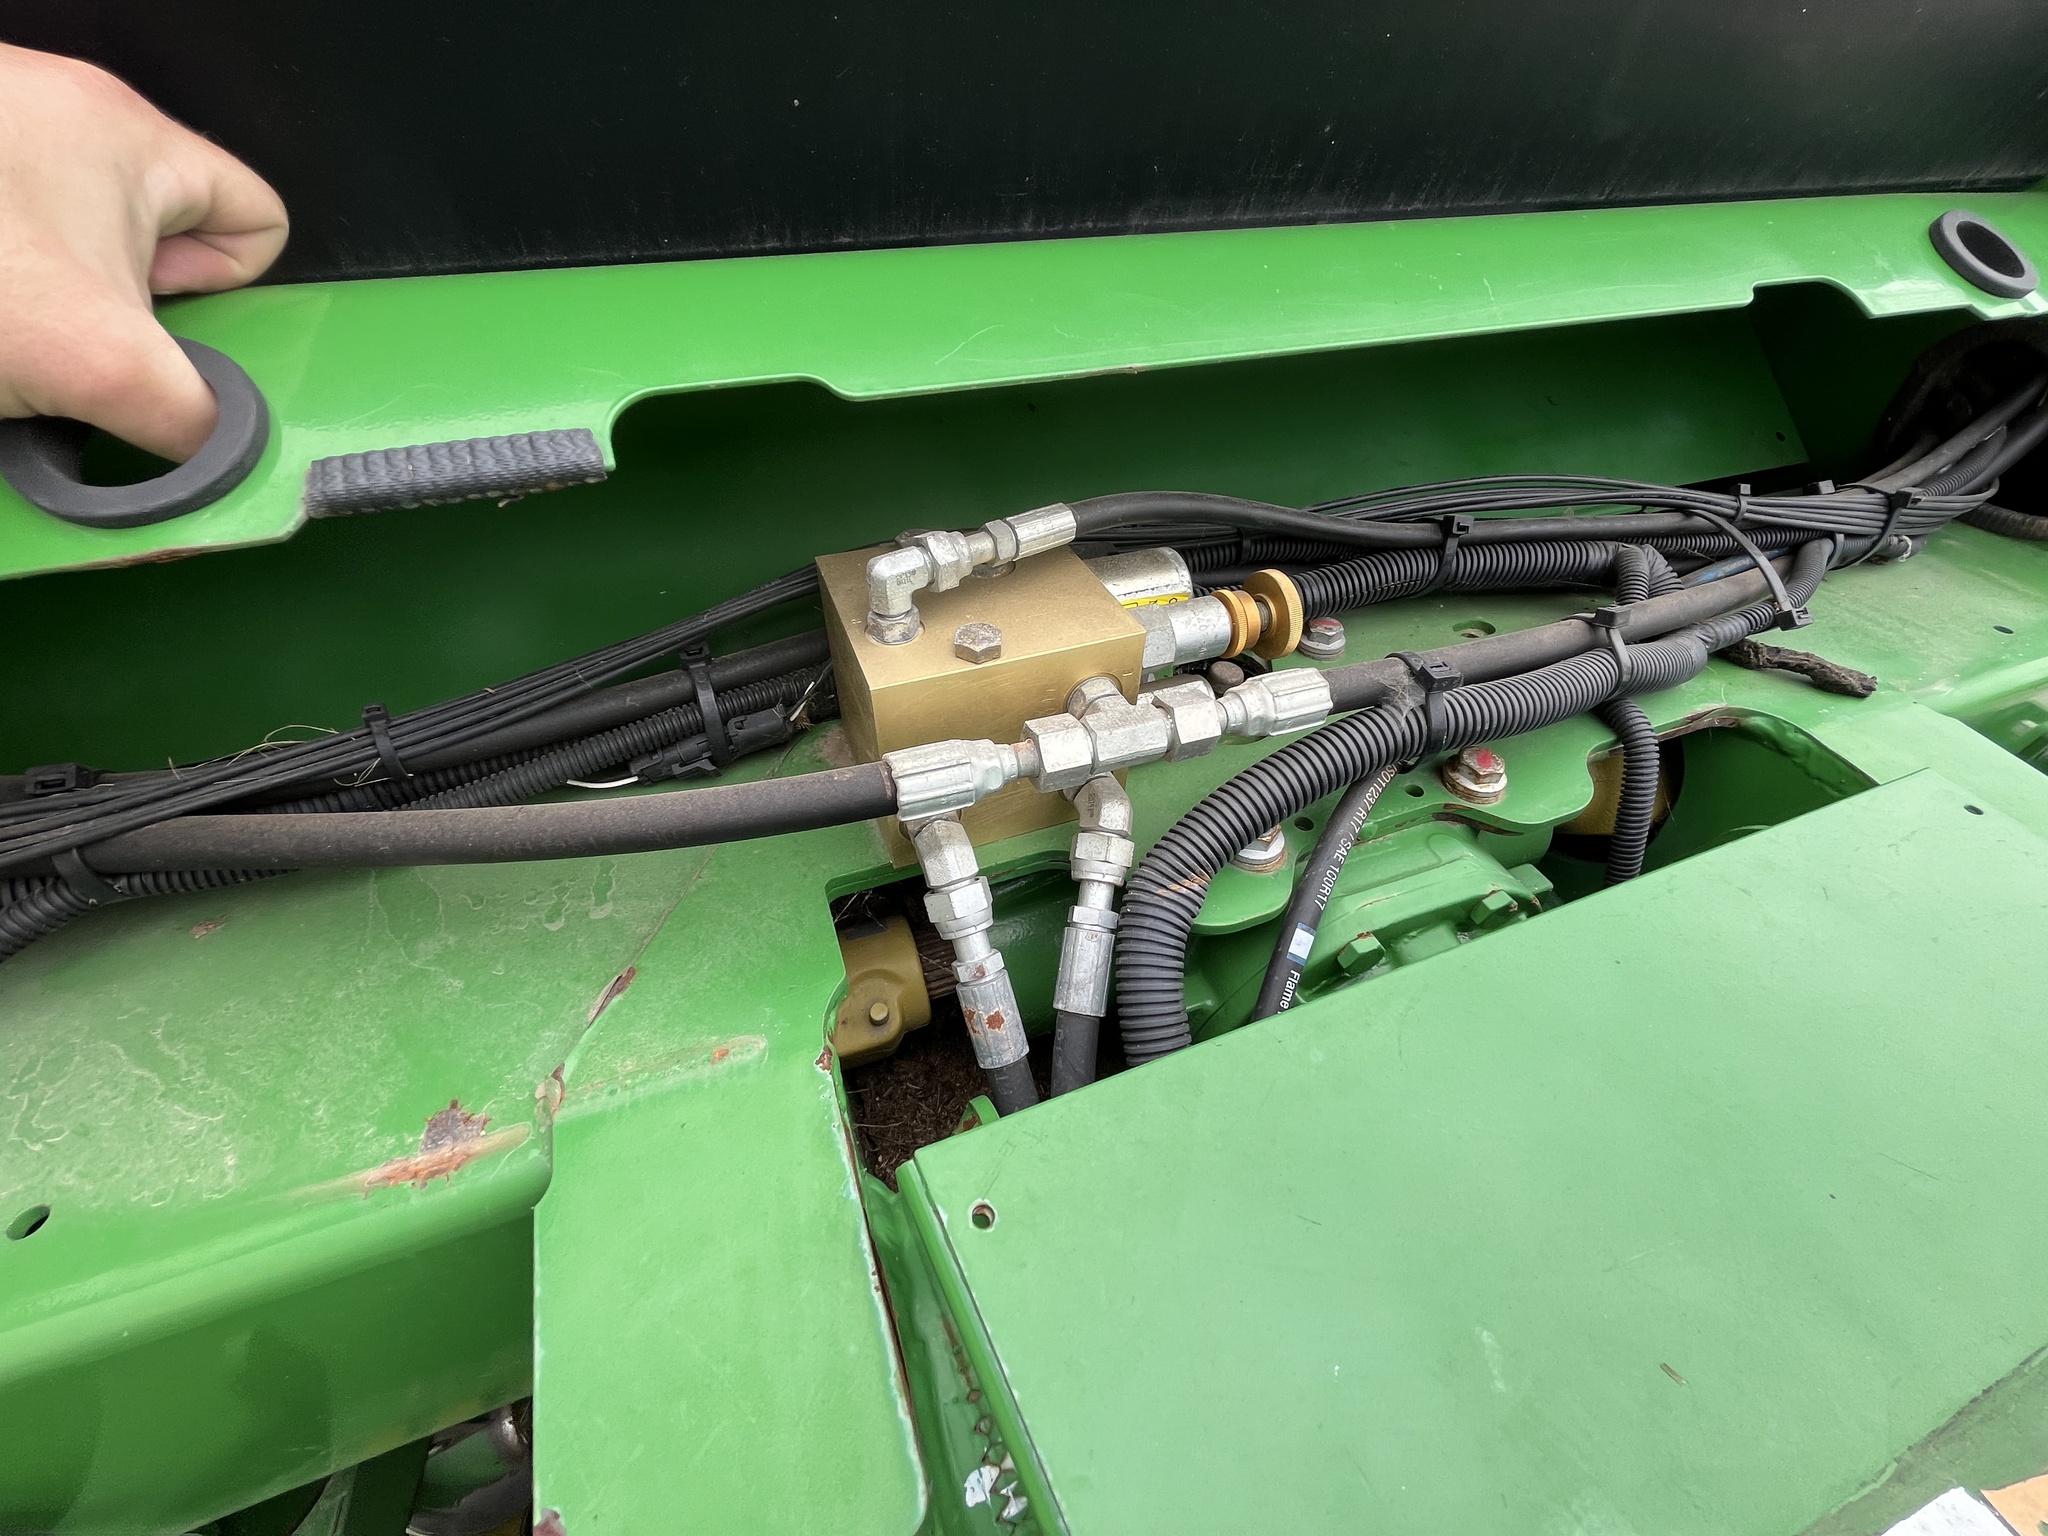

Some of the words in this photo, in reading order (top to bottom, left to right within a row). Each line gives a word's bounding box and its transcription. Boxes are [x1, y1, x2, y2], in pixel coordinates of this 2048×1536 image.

[1350, 807, 1367, 834] R17
[1333, 838, 1352, 865] SAE
[1314, 864, 1340, 911] 100R17
[1279, 969, 1301, 1009] Flame
